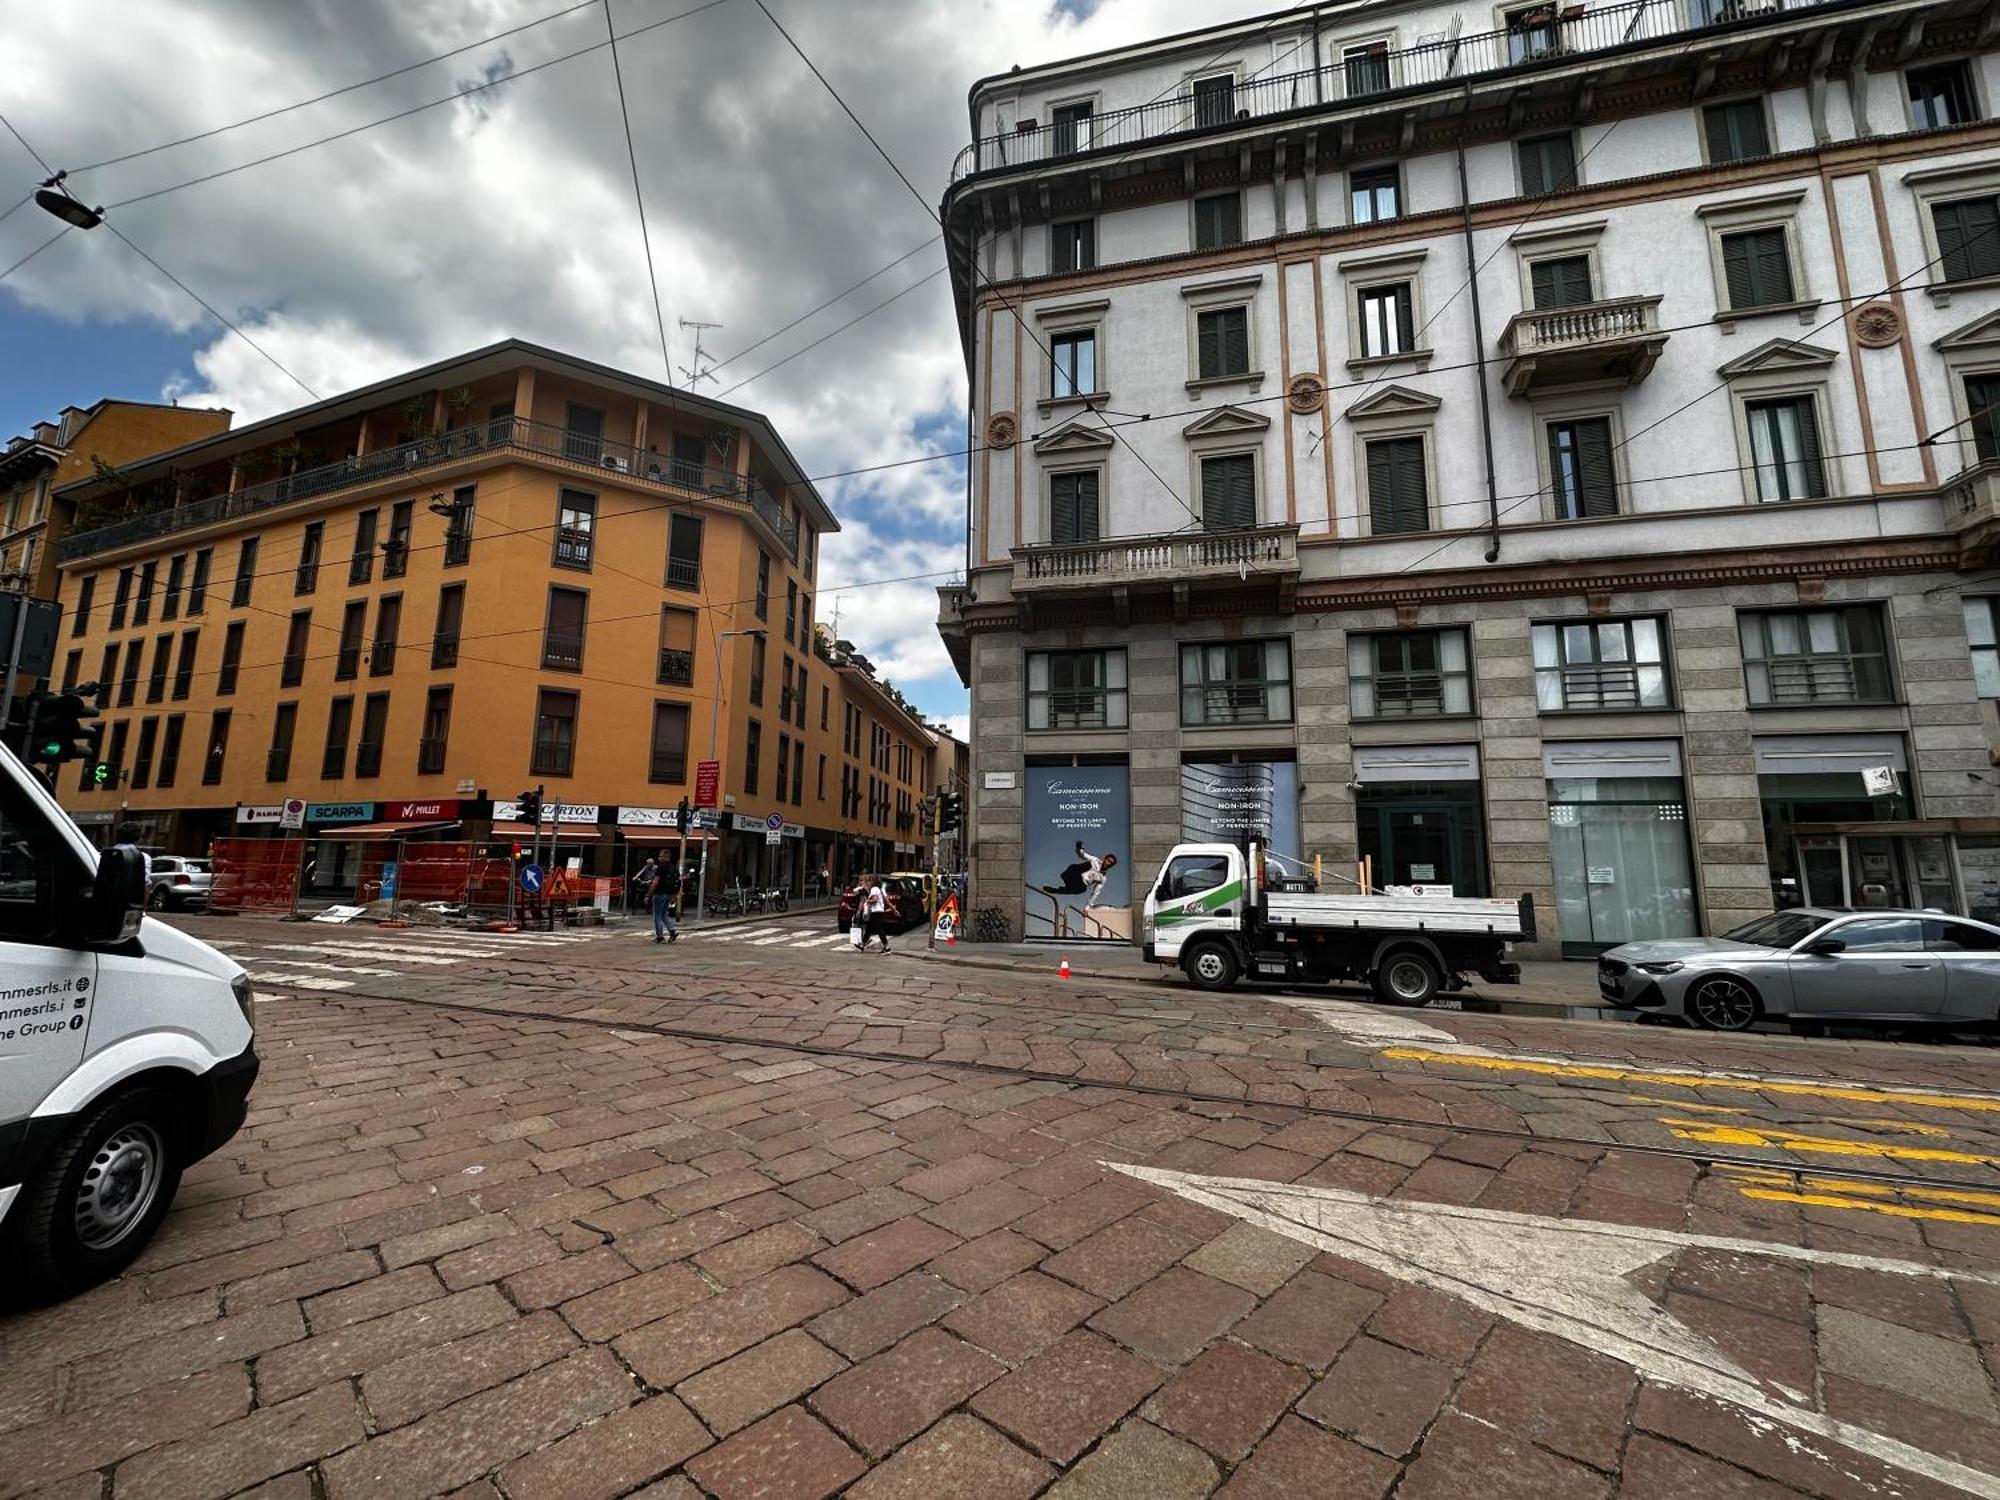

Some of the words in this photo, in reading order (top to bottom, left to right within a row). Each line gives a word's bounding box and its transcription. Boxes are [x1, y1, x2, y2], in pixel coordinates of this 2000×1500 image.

[315, 807, 364, 818] SCARPA
[416, 805, 440, 815] MILLET
[20, 1020, 66, 1037] Group
